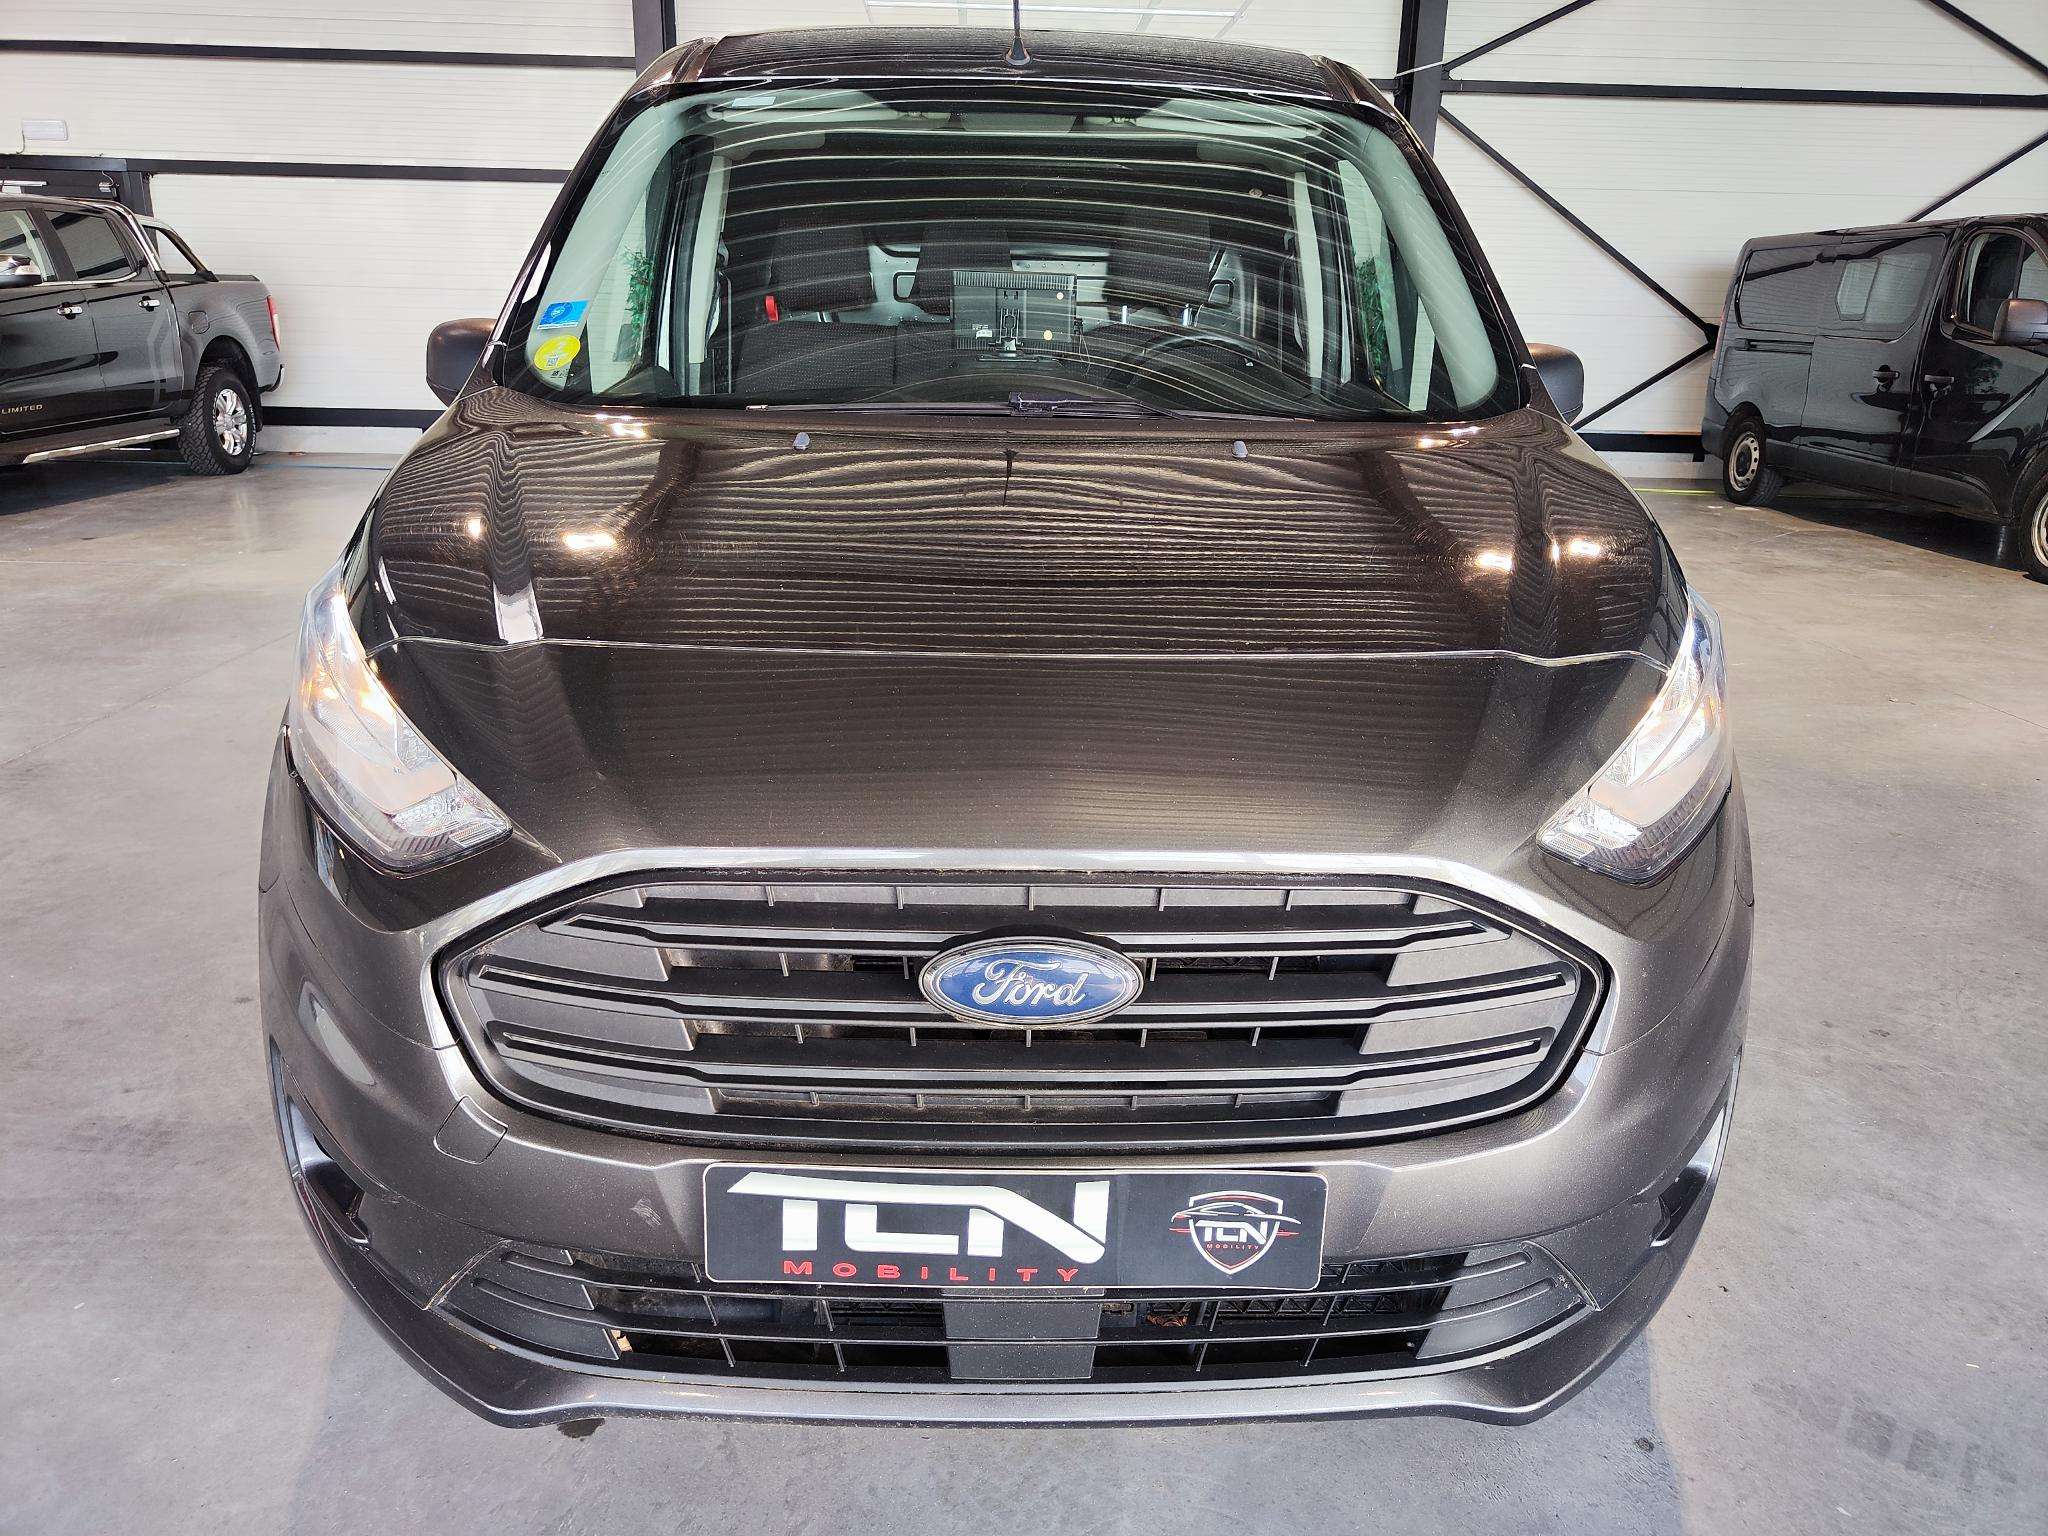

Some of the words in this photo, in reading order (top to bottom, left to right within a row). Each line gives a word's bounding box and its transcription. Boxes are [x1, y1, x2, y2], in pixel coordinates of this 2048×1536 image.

[1, 404, 43, 415] LIMITED
[972, 958, 1089, 1007] Ford
[1206, 1243, 1260, 1251] MOBILITY
[783, 1260, 1079, 1282] MOBILITY
